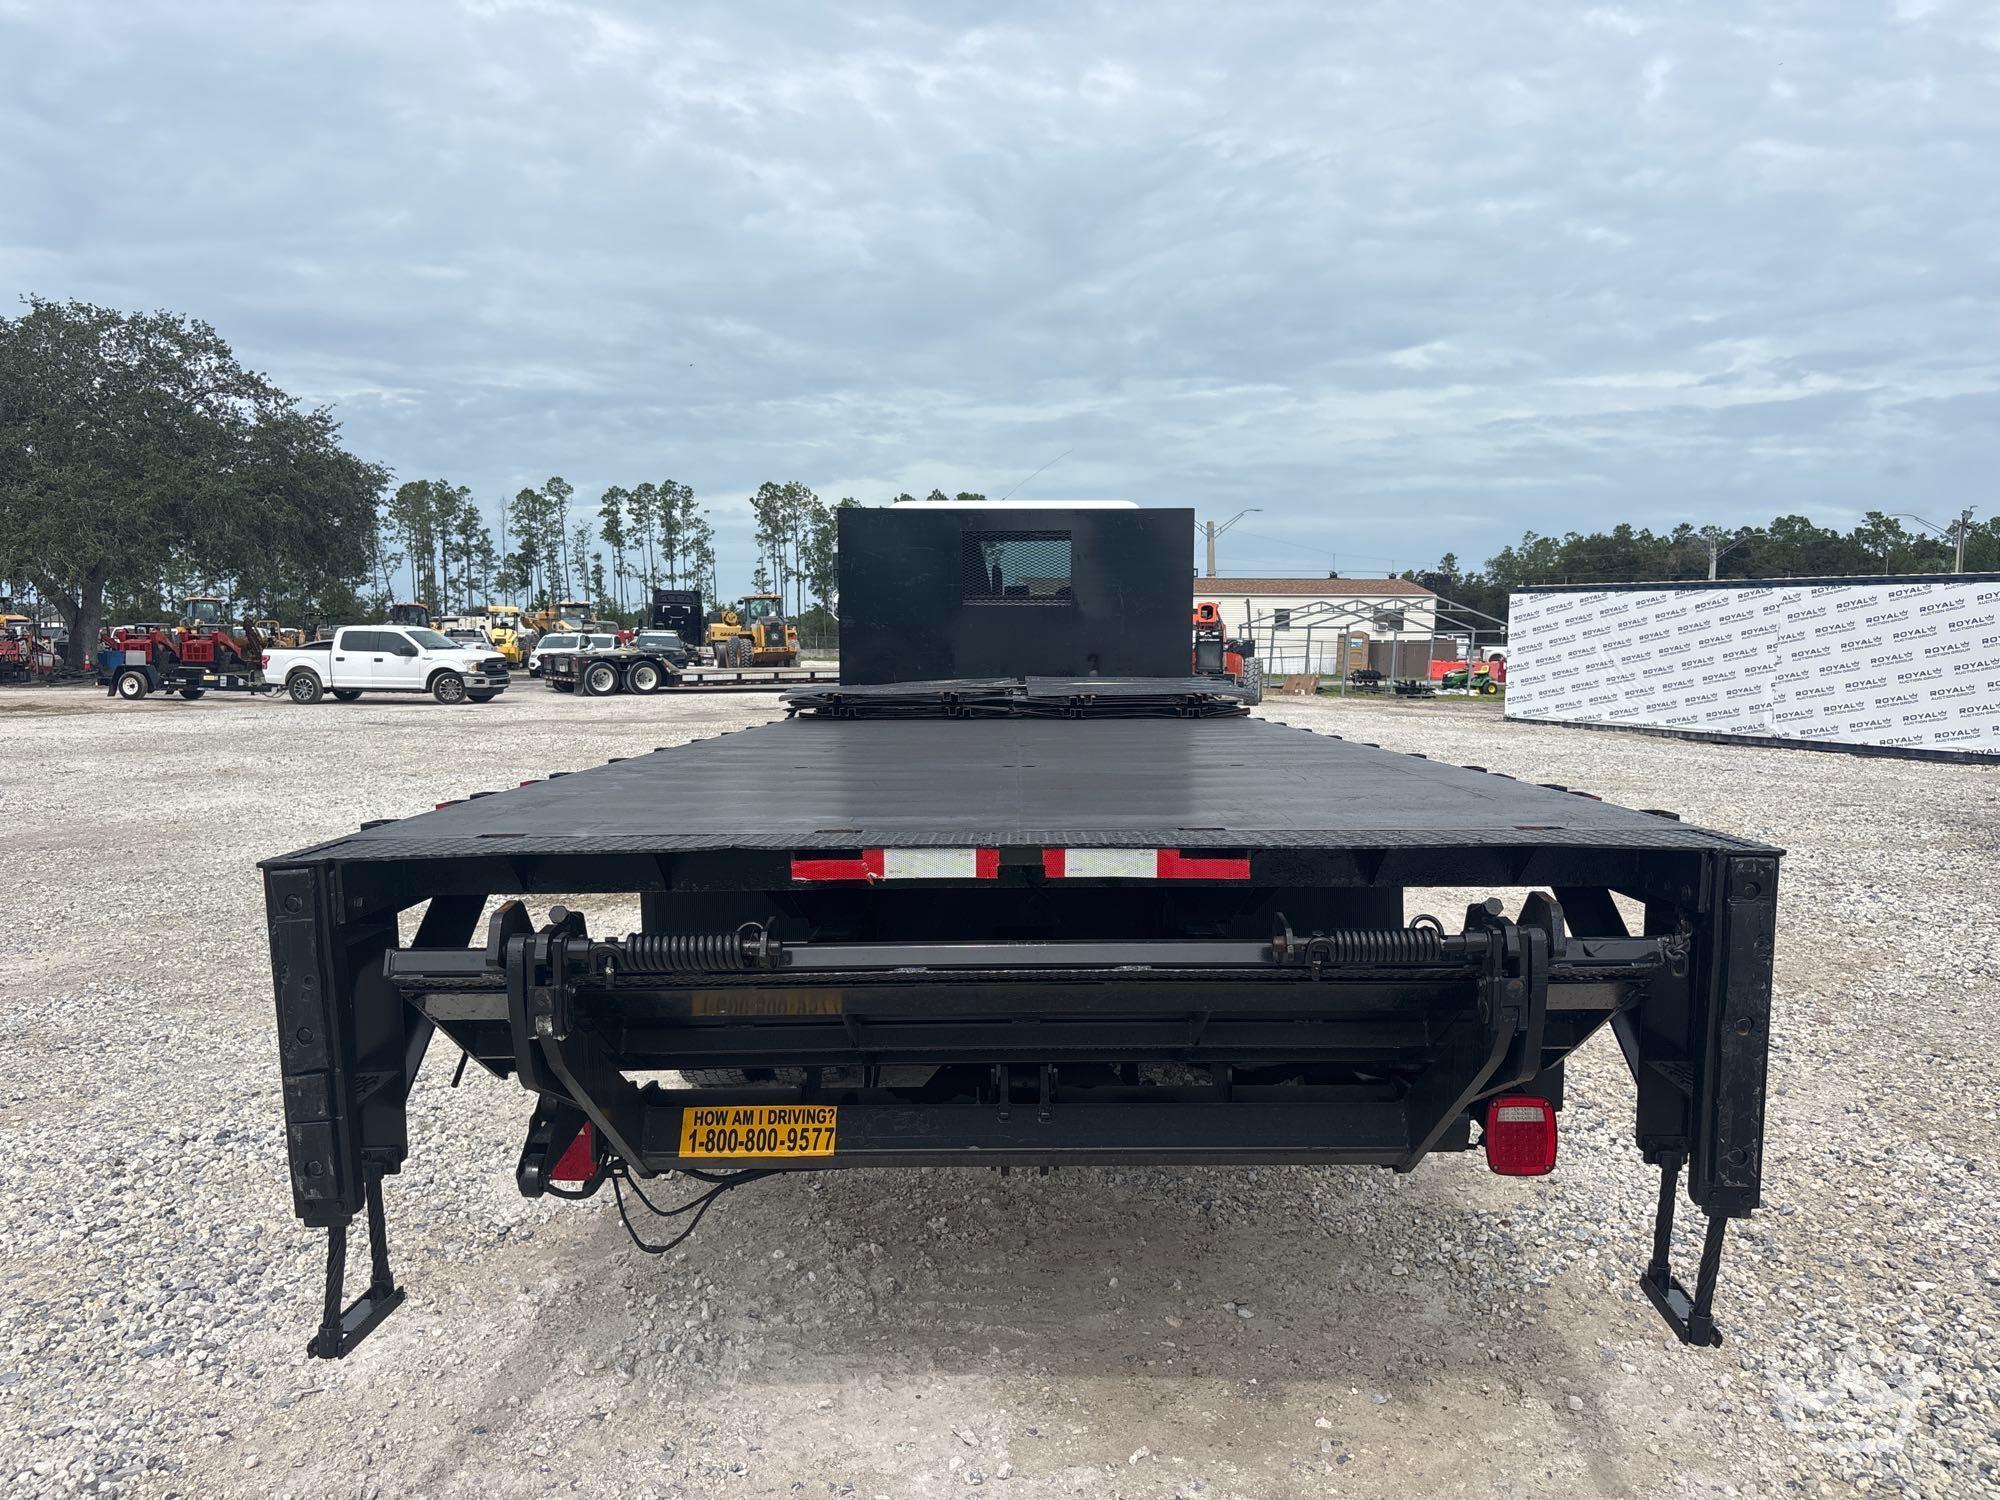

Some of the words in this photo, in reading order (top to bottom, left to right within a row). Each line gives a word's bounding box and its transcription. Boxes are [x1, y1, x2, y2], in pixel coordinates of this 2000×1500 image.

[1738, 588, 1765, 599] ROYAL
[1888, 586, 1922, 598] ROYAL
[1977, 591, 2000, 601] ROY
[1580, 594, 1601, 603] ROYAL
[1636, 596, 1660, 606] ROYAL
[1546, 603, 1567, 612] ROYAL
[1695, 599, 1721, 609] ROYAL
[1763, 604, 1781, 612] ROY
[1836, 598, 1868, 609] ROYAL
[1919, 601, 1955, 612] ROYAL
[1600, 606, 1622, 615] ROYAL
[1655, 609, 1680, 619] ROYAL
[1787, 609, 1817, 620] ROYAL
[1514, 612, 1534, 620] ROYAL
[1565, 615, 1586, 623] ROYAL
[1719, 612, 1746, 622] ROYAL
[1866, 612, 1899, 623] ROYAL
[1618, 618, 1641, 627] ROYAL
[1678, 622, 1703, 631] ROYAL
[1948, 617, 1984, 628] ROYAL
[1532, 623, 1553, 632] ROYAL
[1583, 627, 1605, 636] ROYAL
[1741, 626, 1769, 636] ROYAL
[1815, 623, 1846, 634] ROYAL
[1639, 631, 1663, 640] ROYAL
[1778, 632, 1796, 640] YAL
[1893, 628, 1927, 639] ROYAL
[1549, 636, 1570, 644] ROYAL
[1603, 640, 1625, 648] ROYAL
[1699, 636, 1725, 645] ROYAL
[1841, 638, 1873, 649] ROYAL
[1517, 644, 1537, 652] ROYAL
[1568, 648, 1590, 656] ROYAL
[1659, 645, 1683, 654] ROYAL
[1925, 643, 1960, 654] ROYAL
[1621, 653, 1644, 662] ROYAL
[1723, 649, 1750, 658] ROYAL
[1791, 648, 1821, 658] ROYAL
[1682, 658, 1707, 667] ROYAL
[1870, 653, 1904, 664] ROYAL
[1586, 661, 1608, 669] ROYAL
[1745, 664, 1772, 673] ROYAL
[1819, 663, 1850, 673] ROYAL
[1954, 660, 1990, 671] ROYAL
[1643, 666, 1667, 675] ROYAL
[1898, 670, 1932, 680] ROYAL
[1606, 674, 1629, 682] ROYAL
[1702, 672, 1728, 681] ROYAL
[1662, 680, 1687, 689] ROYAL
[1845, 679, 1877, 689] ROYAL
[1625, 688, 1648, 696] ROYAL
[1726, 686, 1753, 695] ROYAL
[1796, 687, 1826, 696] ROYAL
[1930, 686, 1965, 696] ROYAL
[1685, 694, 1710, 703] ROYAL
[1875, 695, 1908, 704] ROYAL
[1749, 702, 1772, 711] ROYA
[1824, 703, 1855, 712] ROYAL
[1959, 703, 1996, 713] ROYAL
[1706, 710, 1732, 718] ROYAL
[1776, 710, 1805, 719] ROYAL
[1903, 712, 1937, 722] ROYAL
[1850, 719, 1882, 728] ROYAL
[1800, 726, 1830, 735] ROYAL
[1934, 729, 1970, 739] ROYAL
[1880, 736, 1913, 745] ROYAL
[694, 1110, 728, 1126] HOW
[732, 1110, 754, 1125] AM
[759, 1110, 763, 1124] I
[768, 1109, 835, 1124] DRIVING?
[689, 1127, 835, 1153] 1-800-800-9577
